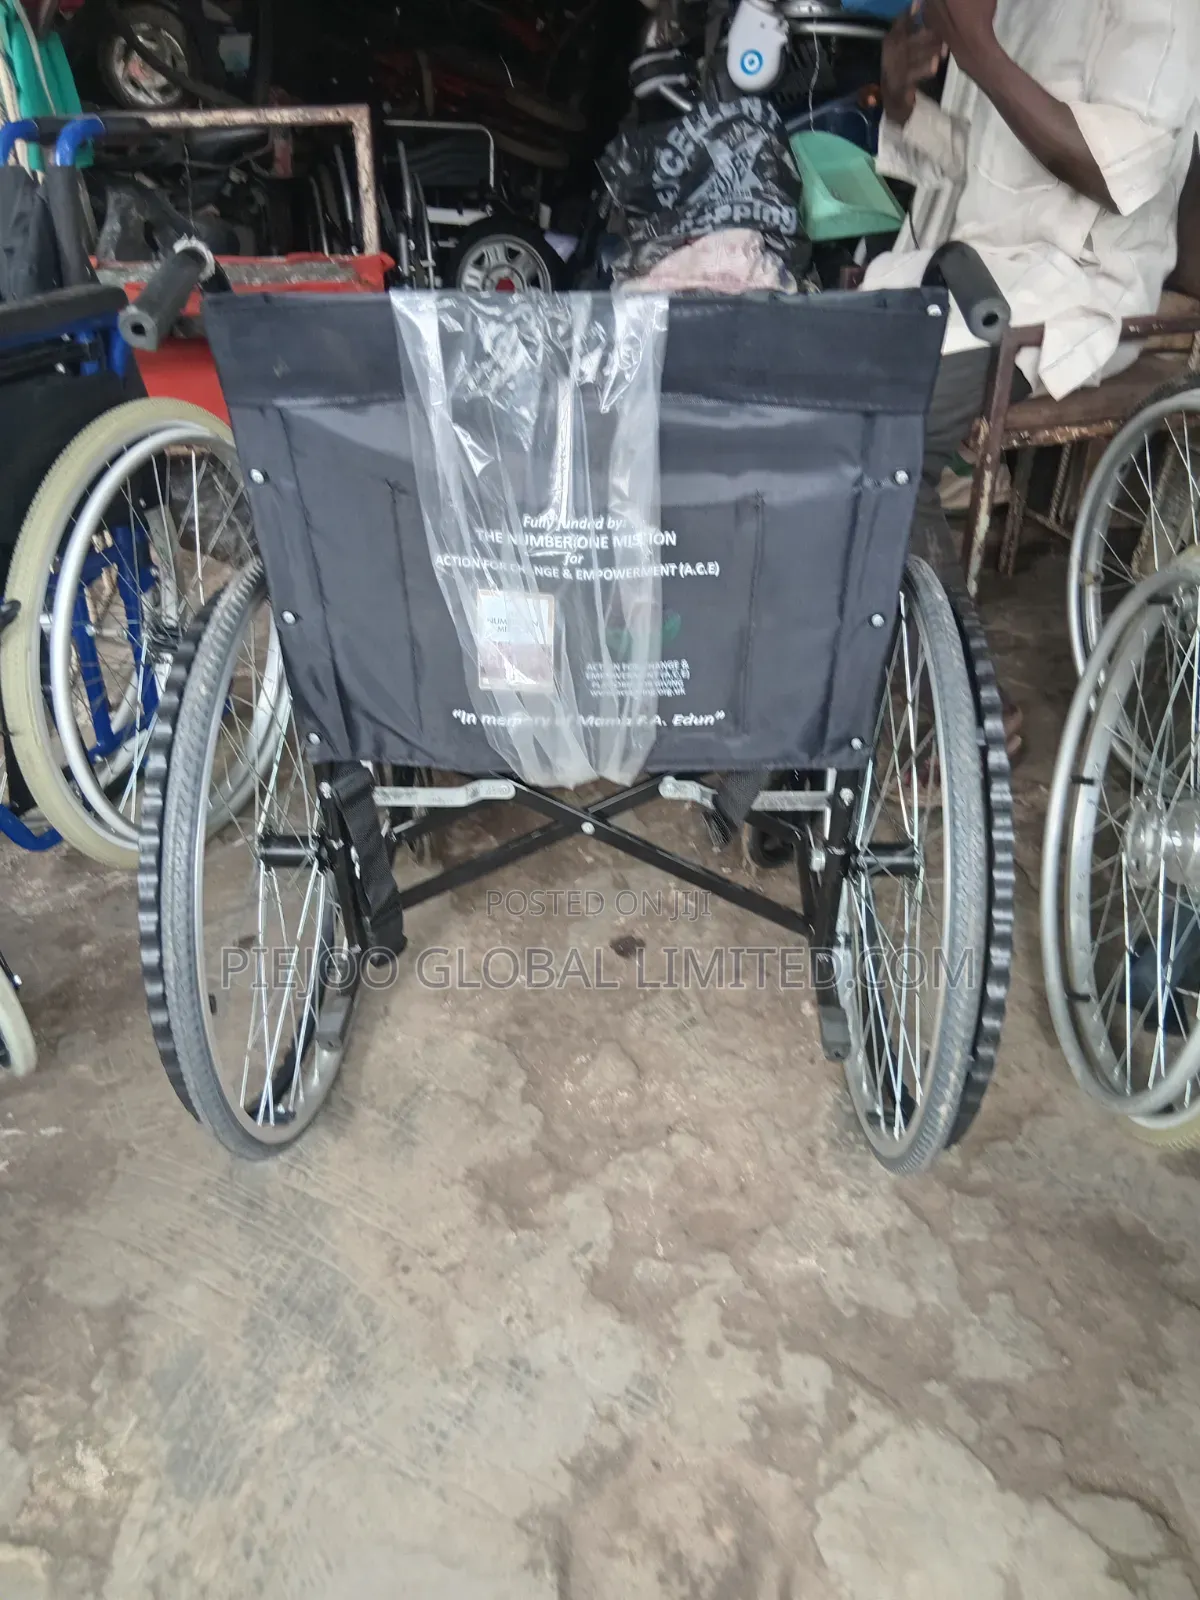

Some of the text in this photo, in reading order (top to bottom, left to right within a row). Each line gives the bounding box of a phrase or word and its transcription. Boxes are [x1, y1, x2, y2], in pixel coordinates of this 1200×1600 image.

[522, 513, 556, 531] Fully
[475, 527, 503, 544] THE
[435, 554, 480, 569] ACTION
[510, 563, 560, 579] CHNGE
[562, 568, 573, 581] &
[564, 552, 585, 566] for
